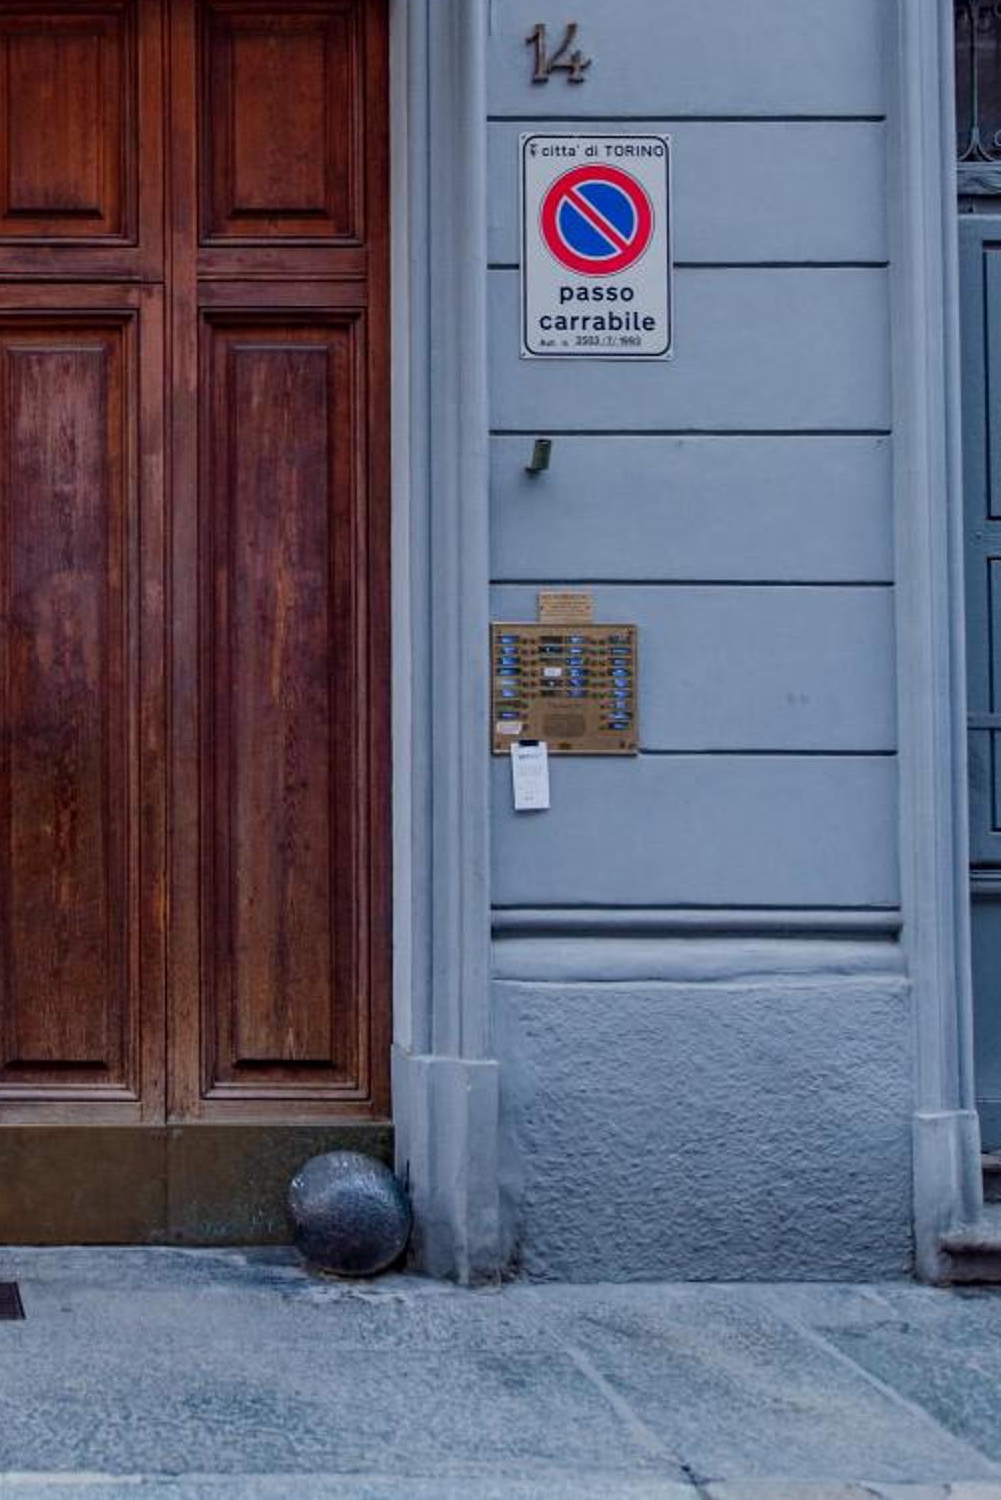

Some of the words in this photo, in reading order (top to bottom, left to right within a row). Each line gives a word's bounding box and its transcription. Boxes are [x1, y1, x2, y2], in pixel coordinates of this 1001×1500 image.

[525, 22, 592, 85] 14
[584, 144, 598, 157] di
[604, 144, 664, 157] TORINO
[559, 286, 634, 305] passo
[539, 311, 656, 331] carrabile
